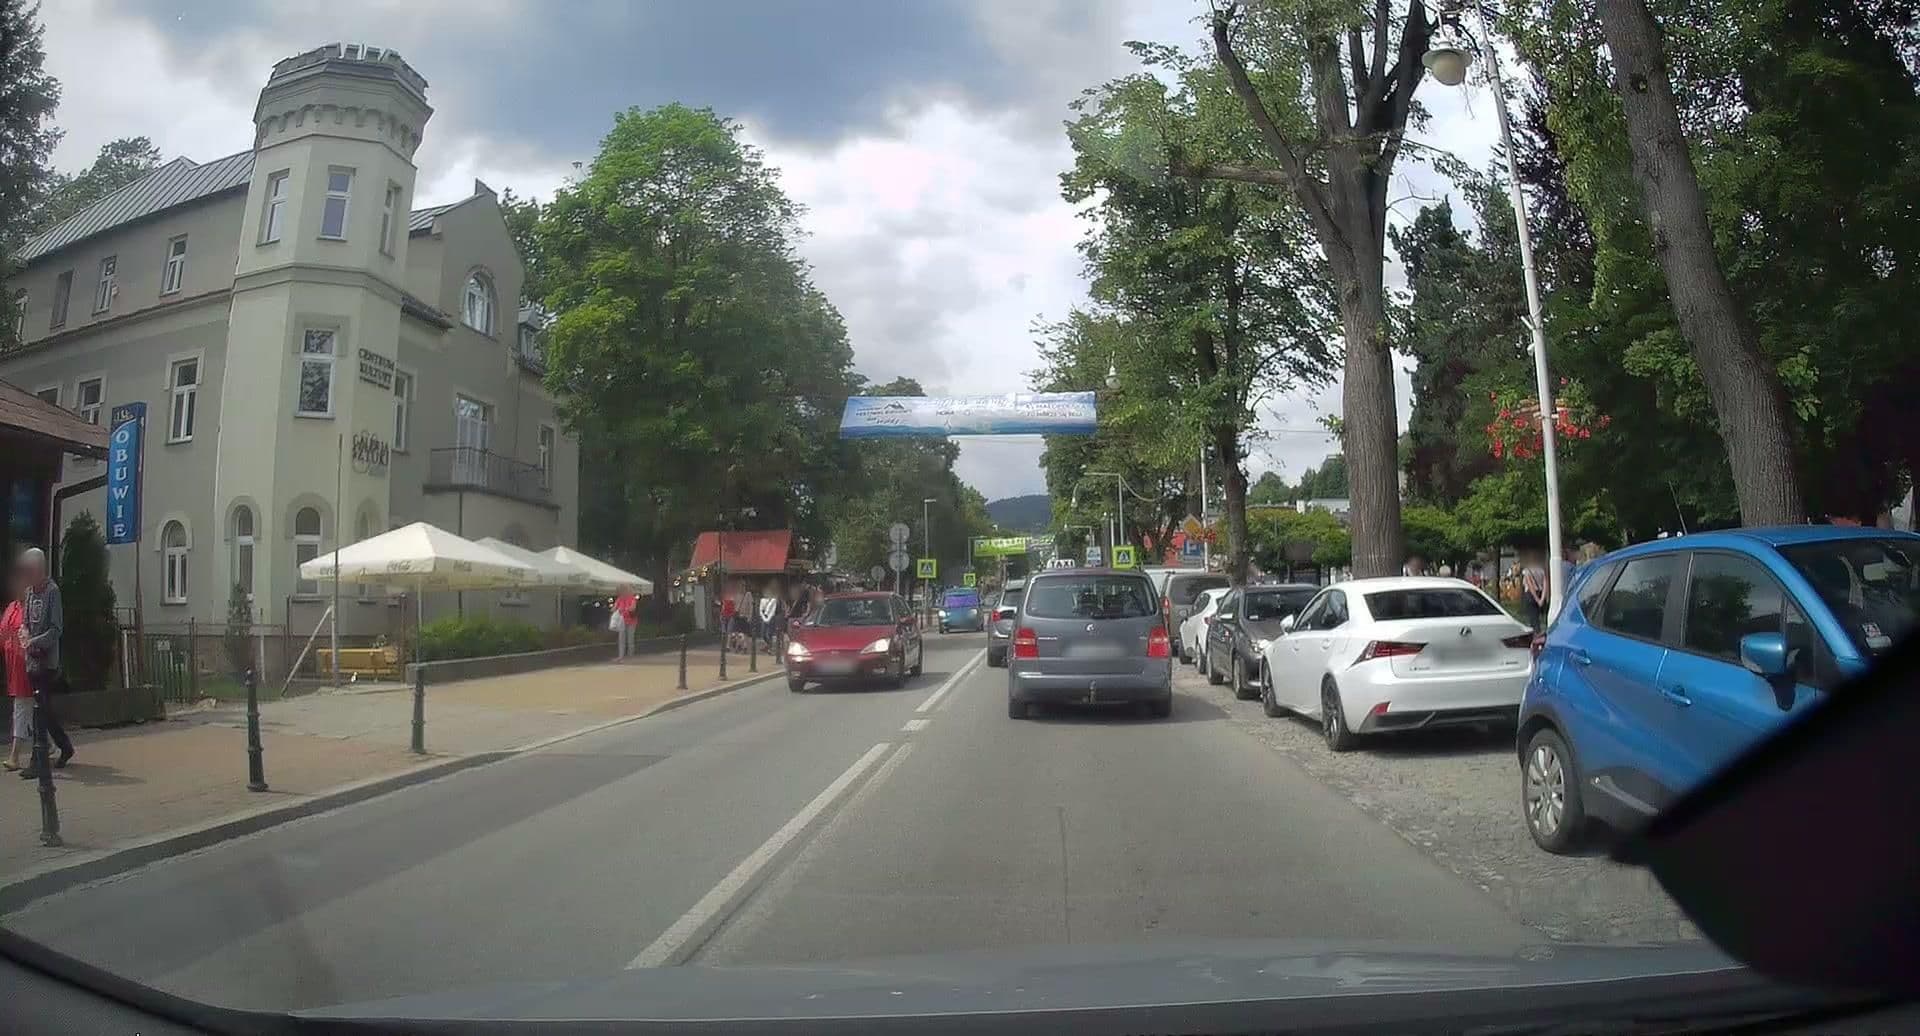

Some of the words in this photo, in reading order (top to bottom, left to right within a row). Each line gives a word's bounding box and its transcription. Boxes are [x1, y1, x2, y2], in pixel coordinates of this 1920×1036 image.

[358, 347, 395, 371] CENTRUM
[359, 362, 392, 383] KULTURY
[113, 430, 130, 538] OBUWIE
[1050, 560, 1073, 569] TAXI
